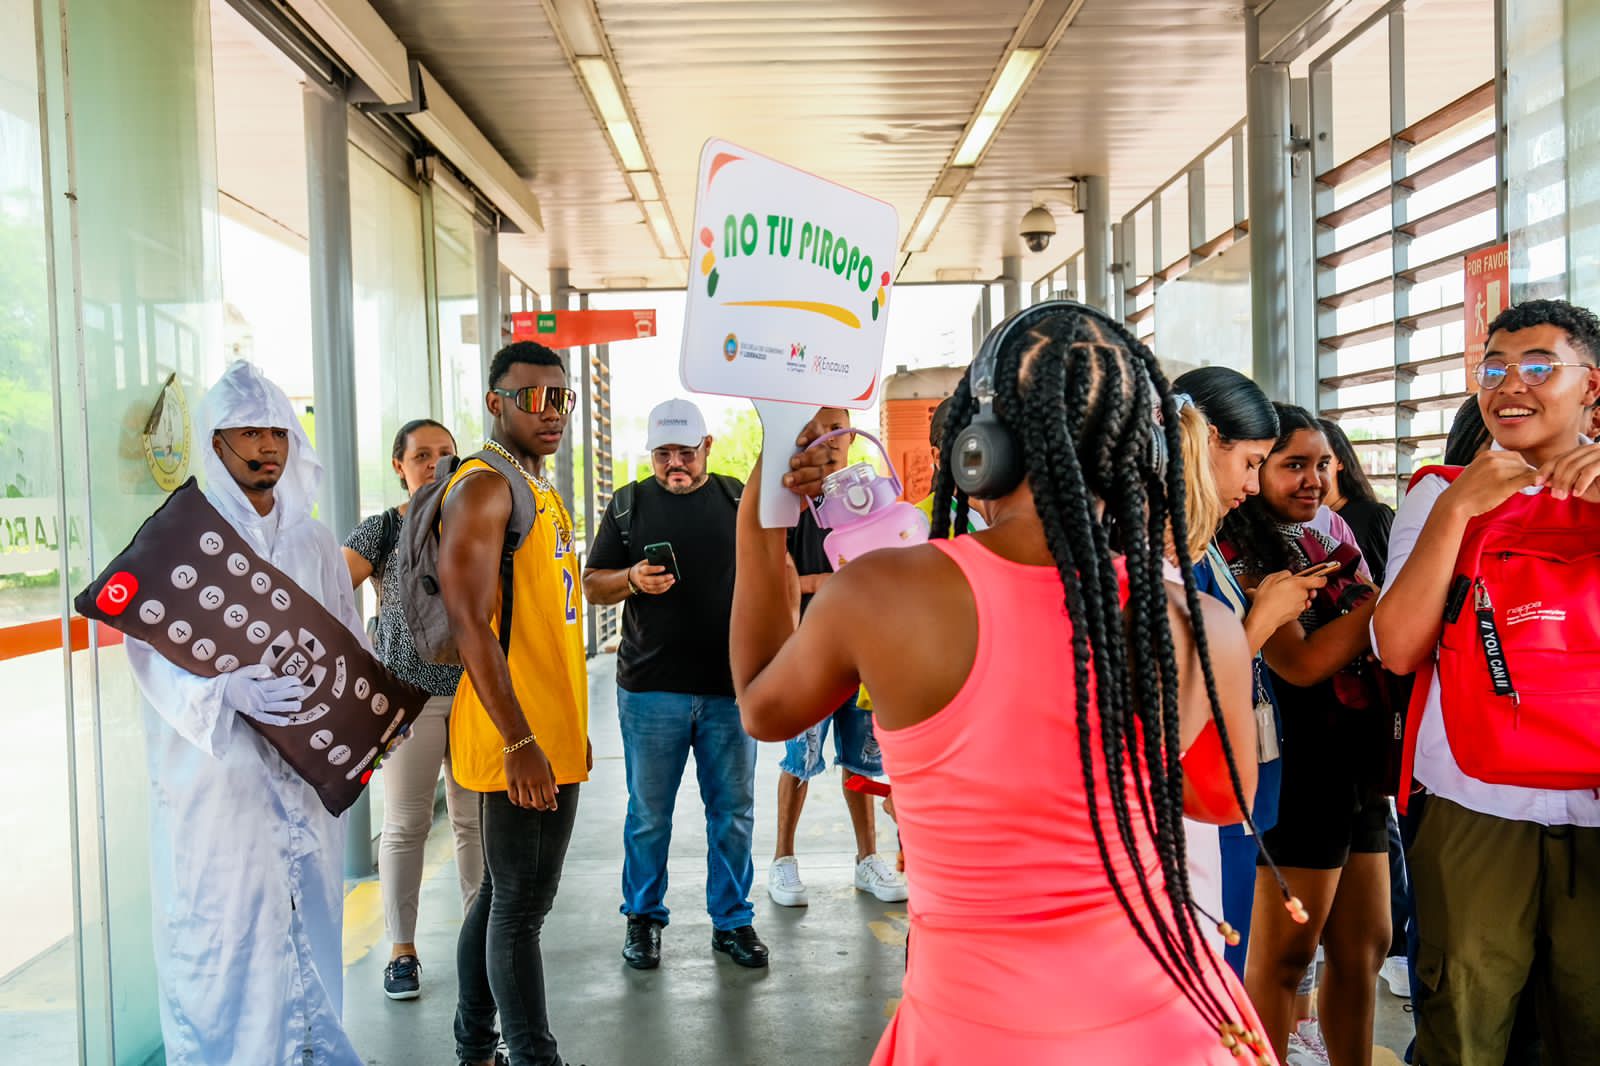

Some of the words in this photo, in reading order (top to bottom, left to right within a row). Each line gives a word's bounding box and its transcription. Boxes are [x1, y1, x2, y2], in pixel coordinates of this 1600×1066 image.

[723, 212, 759, 258] NO
[766, 214, 793, 258] TU
[798, 221, 873, 292] PIROPO
[1468, 258, 1482, 277] POR
[206, 537, 220, 551] 3
[234, 559, 246, 571] 6
[178, 571, 193, 584] 2
[256, 577, 267, 589] 9
[206, 591, 220, 605] 5
[146, 607, 161, 620] 1
[230, 610, 243, 623] 8
[175, 626, 187, 639] 4
[252, 627, 266, 639] 0
[197, 644, 209, 656] 7
[1484, 632, 1499, 656] YOU
[285, 655, 306, 676] OK
[1490, 660, 1506, 679] CAN
[330, 749, 349, 764] MENU
